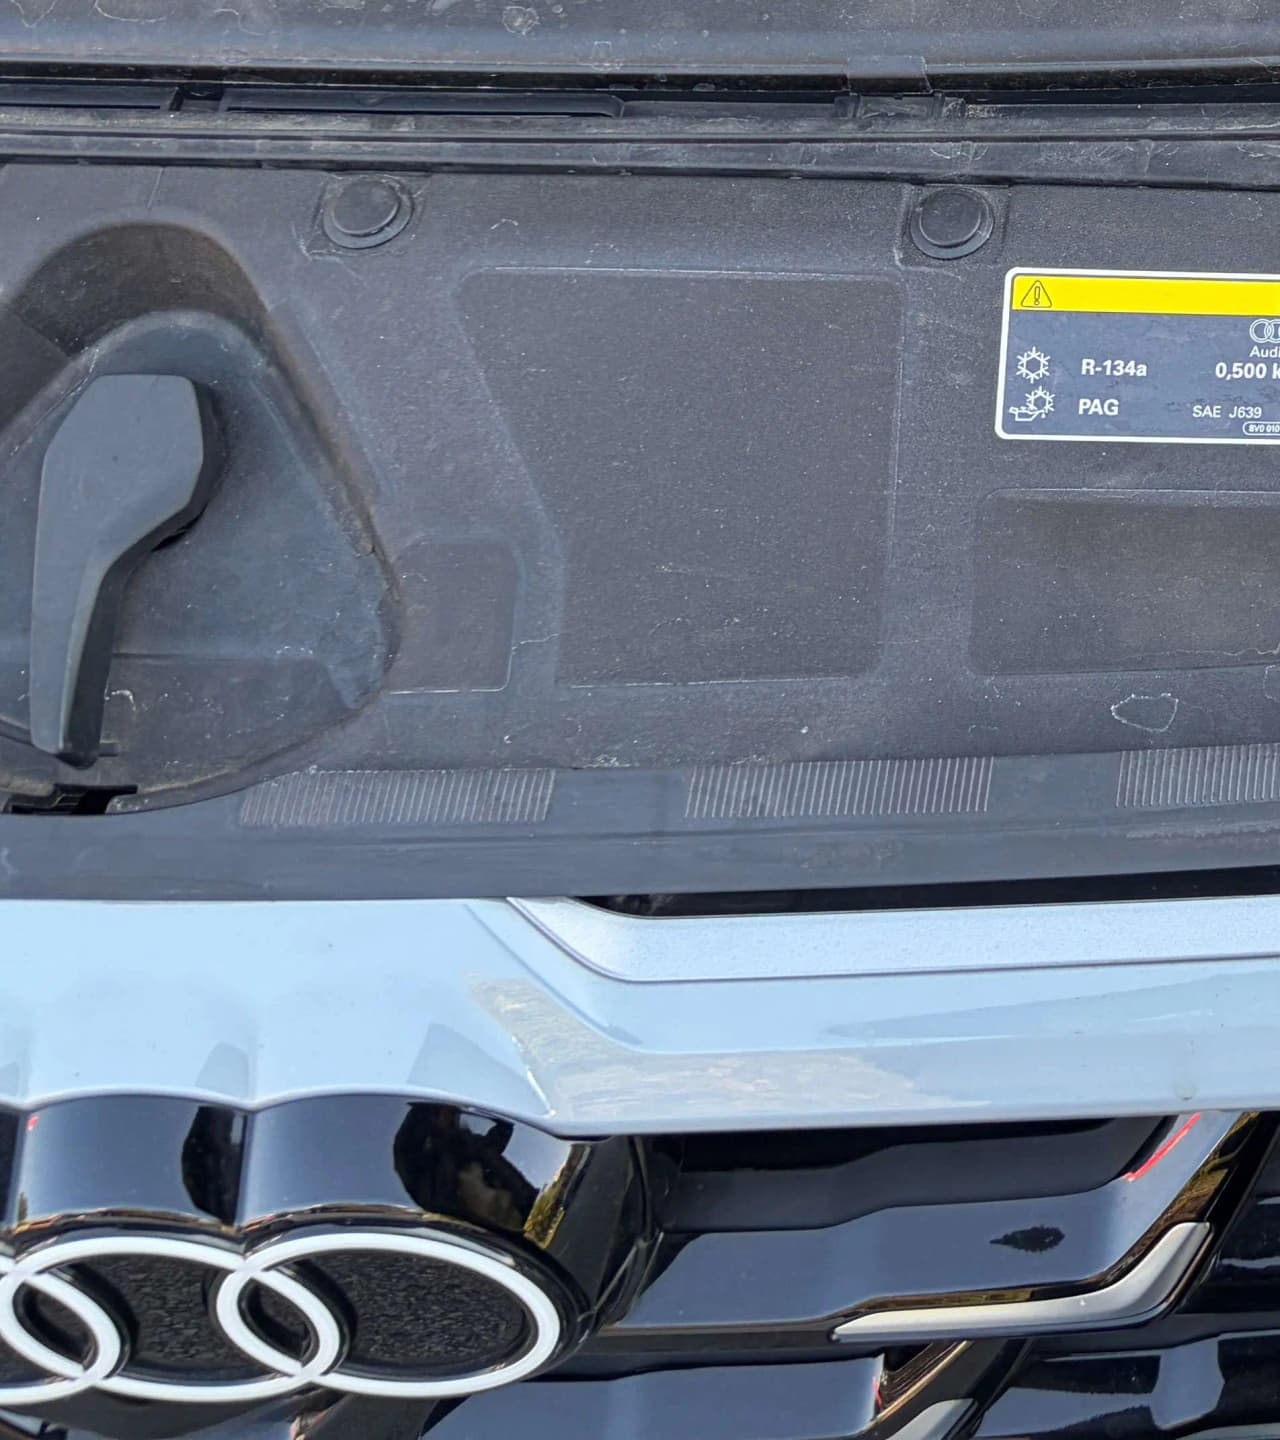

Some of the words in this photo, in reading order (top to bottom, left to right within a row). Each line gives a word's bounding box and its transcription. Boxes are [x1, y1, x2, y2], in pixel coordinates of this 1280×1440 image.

[1081, 359, 1147, 377] R-134a
[1215, 362, 1267, 382] 0,500
[1078, 398, 1120, 417] PAG
[1191, 405, 1223, 420] SAE
[1228, 406, 1263, 420] J639
[1265, 424, 1280, 435] 010
